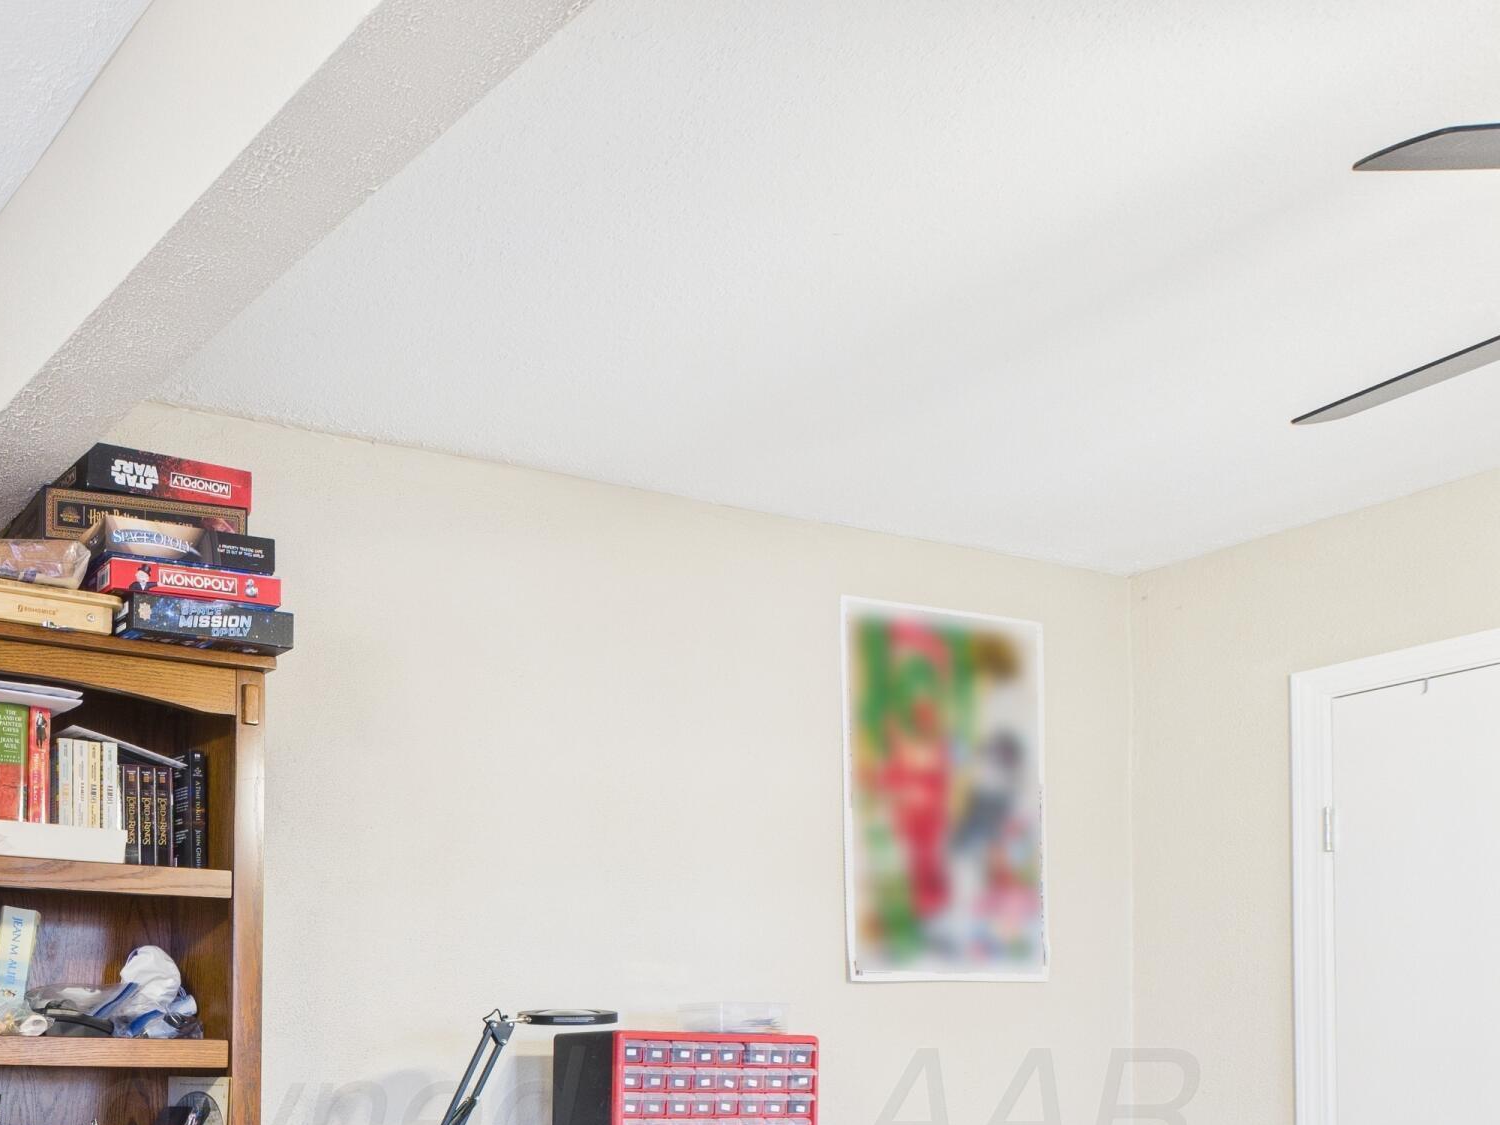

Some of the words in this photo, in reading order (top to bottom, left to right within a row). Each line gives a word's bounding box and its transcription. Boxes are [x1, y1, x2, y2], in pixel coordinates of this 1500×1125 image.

[111, 459, 157, 477] WARS
[114, 470, 159, 490] STAR
[172, 473, 229, 494] MONOPOLY
[162, 571, 235, 592] MONOPOLY
[180, 606, 223, 616] SPACE
[179, 615, 252, 628] MISSION
[211, 627, 250, 637] OPOLY
